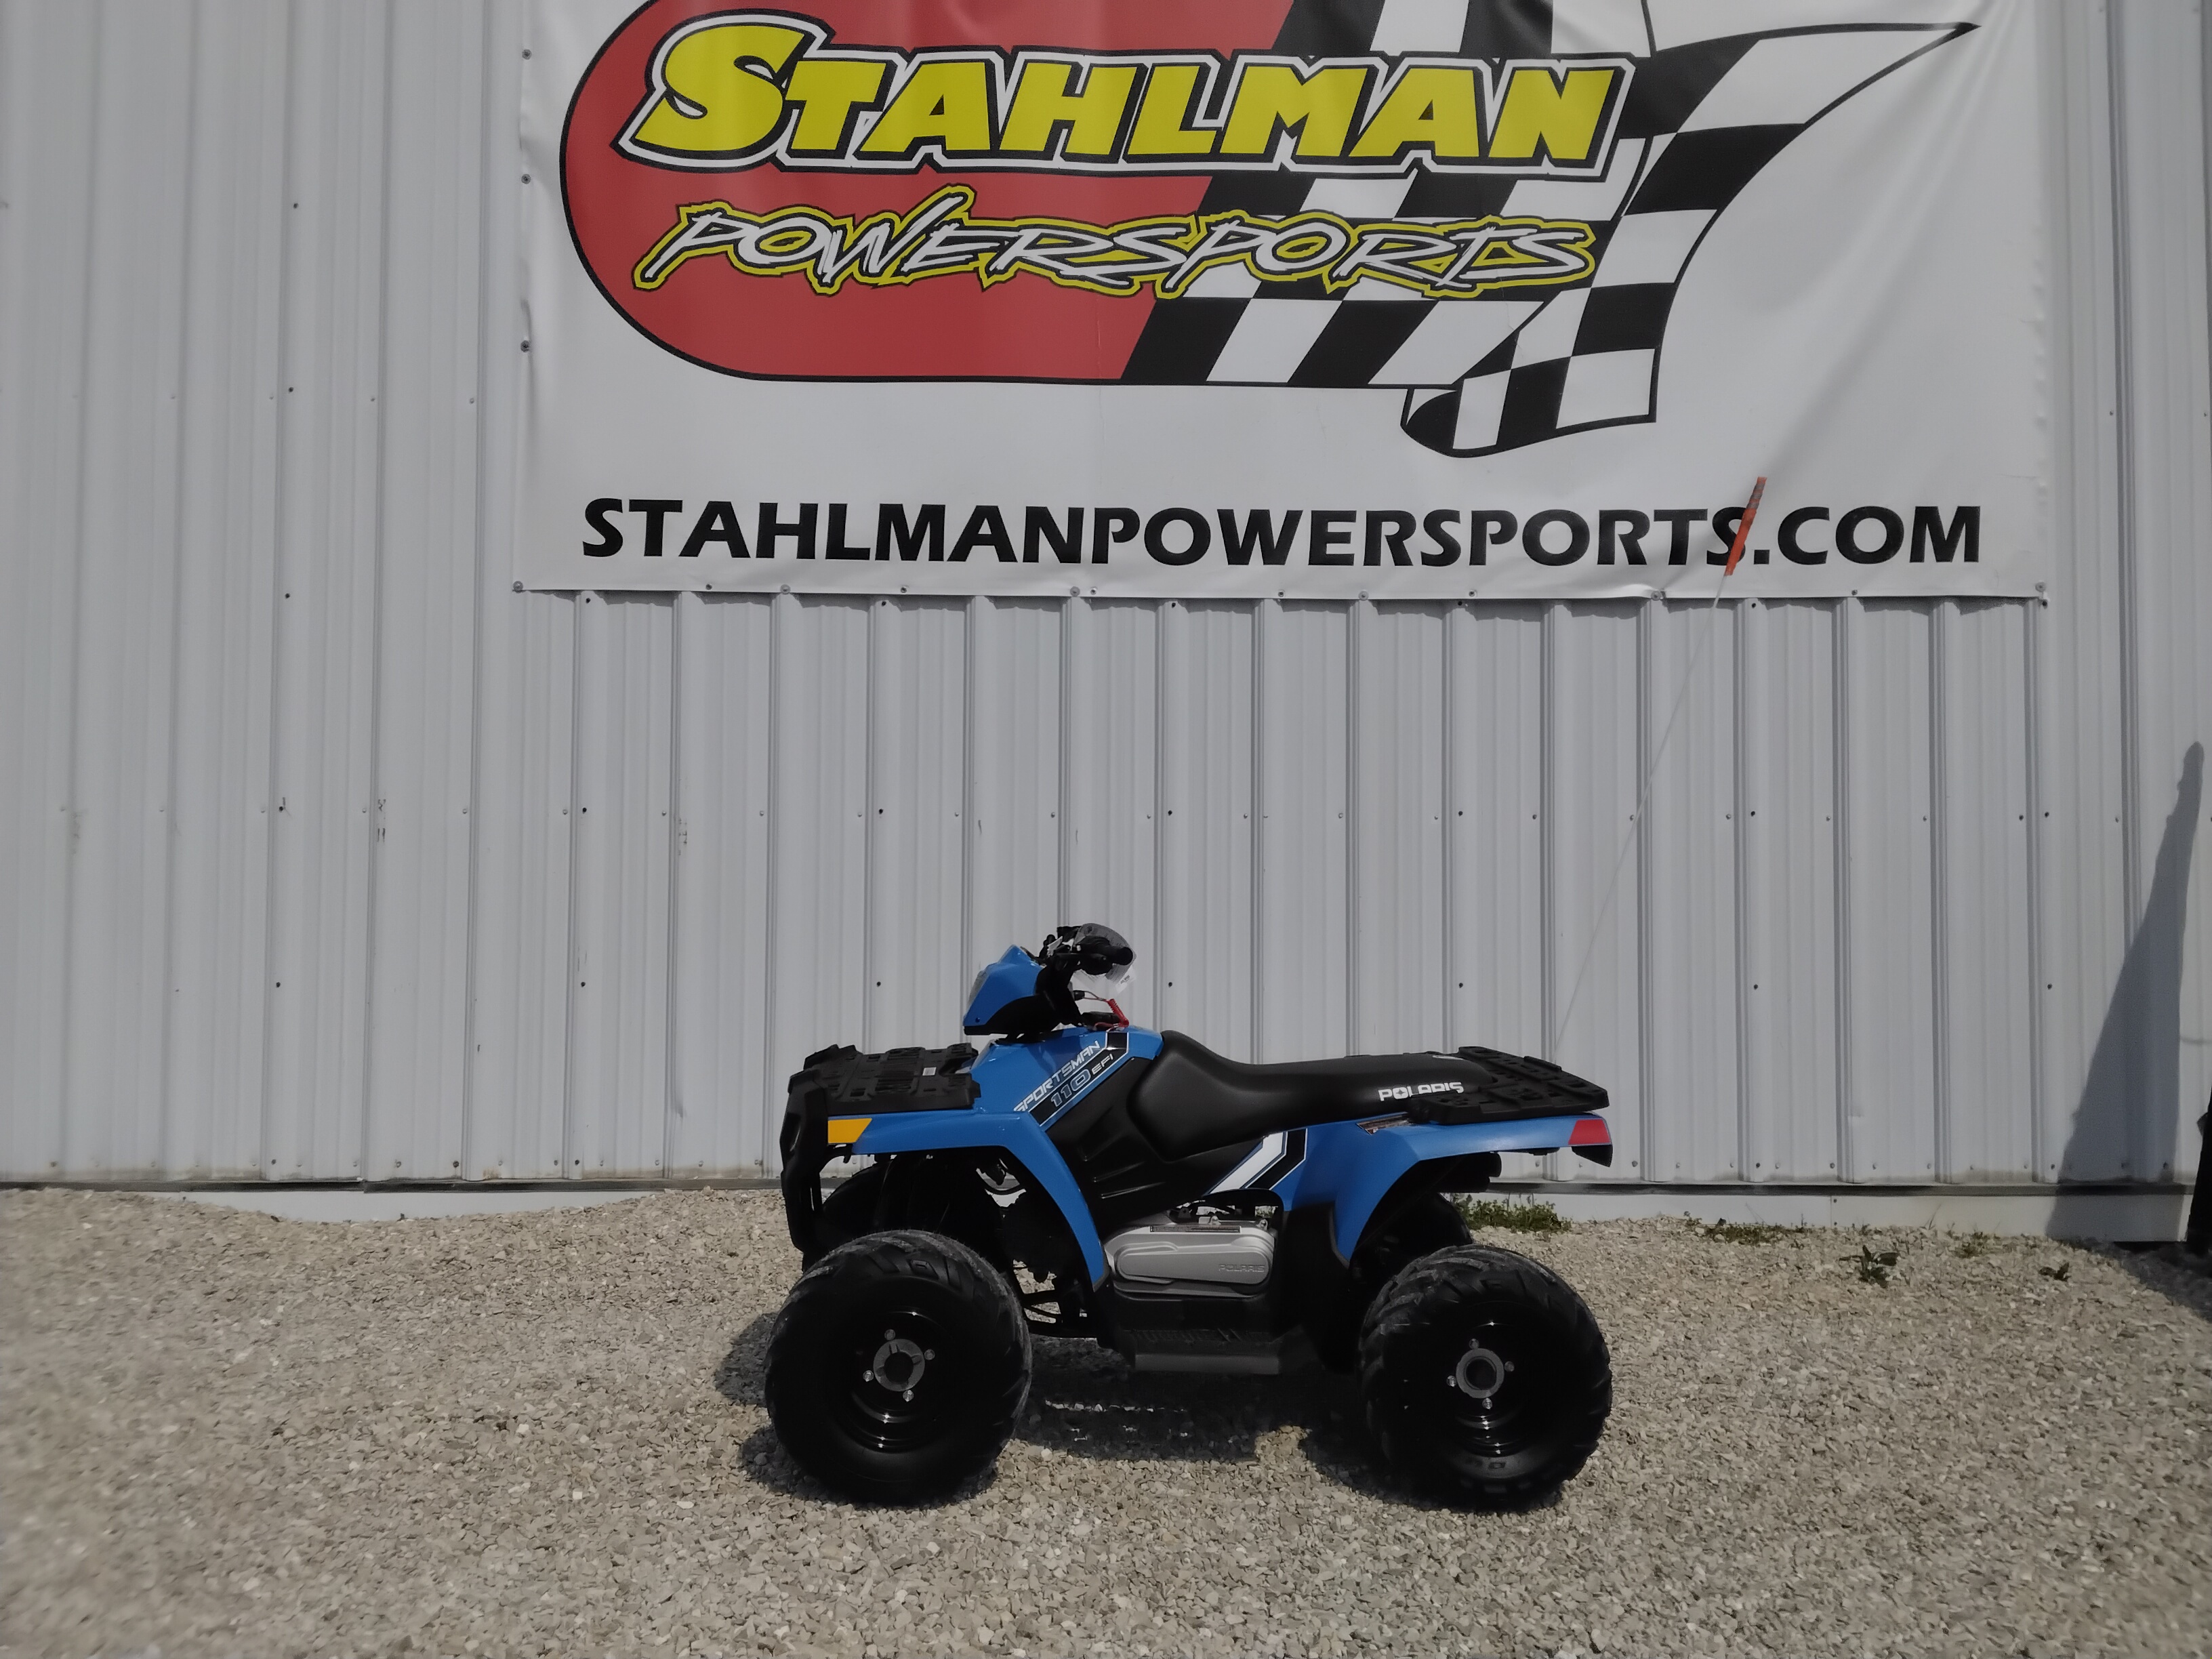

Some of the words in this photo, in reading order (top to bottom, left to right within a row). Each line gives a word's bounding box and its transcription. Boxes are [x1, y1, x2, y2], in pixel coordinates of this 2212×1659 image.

[625, 16, 1622, 168] STAHLMAN
[637, 189, 1591, 294] POWERSPORTS
[582, 498, 1980, 567] STAHLMANPOWERSPORTS.COM
[1014, 1040, 1101, 1111] SPORTSMAN
[1050, 1069, 1091, 1107] 110
[1091, 1053, 1113, 1076] EFI
[1219, 1264, 1265, 1272] POLARIS
